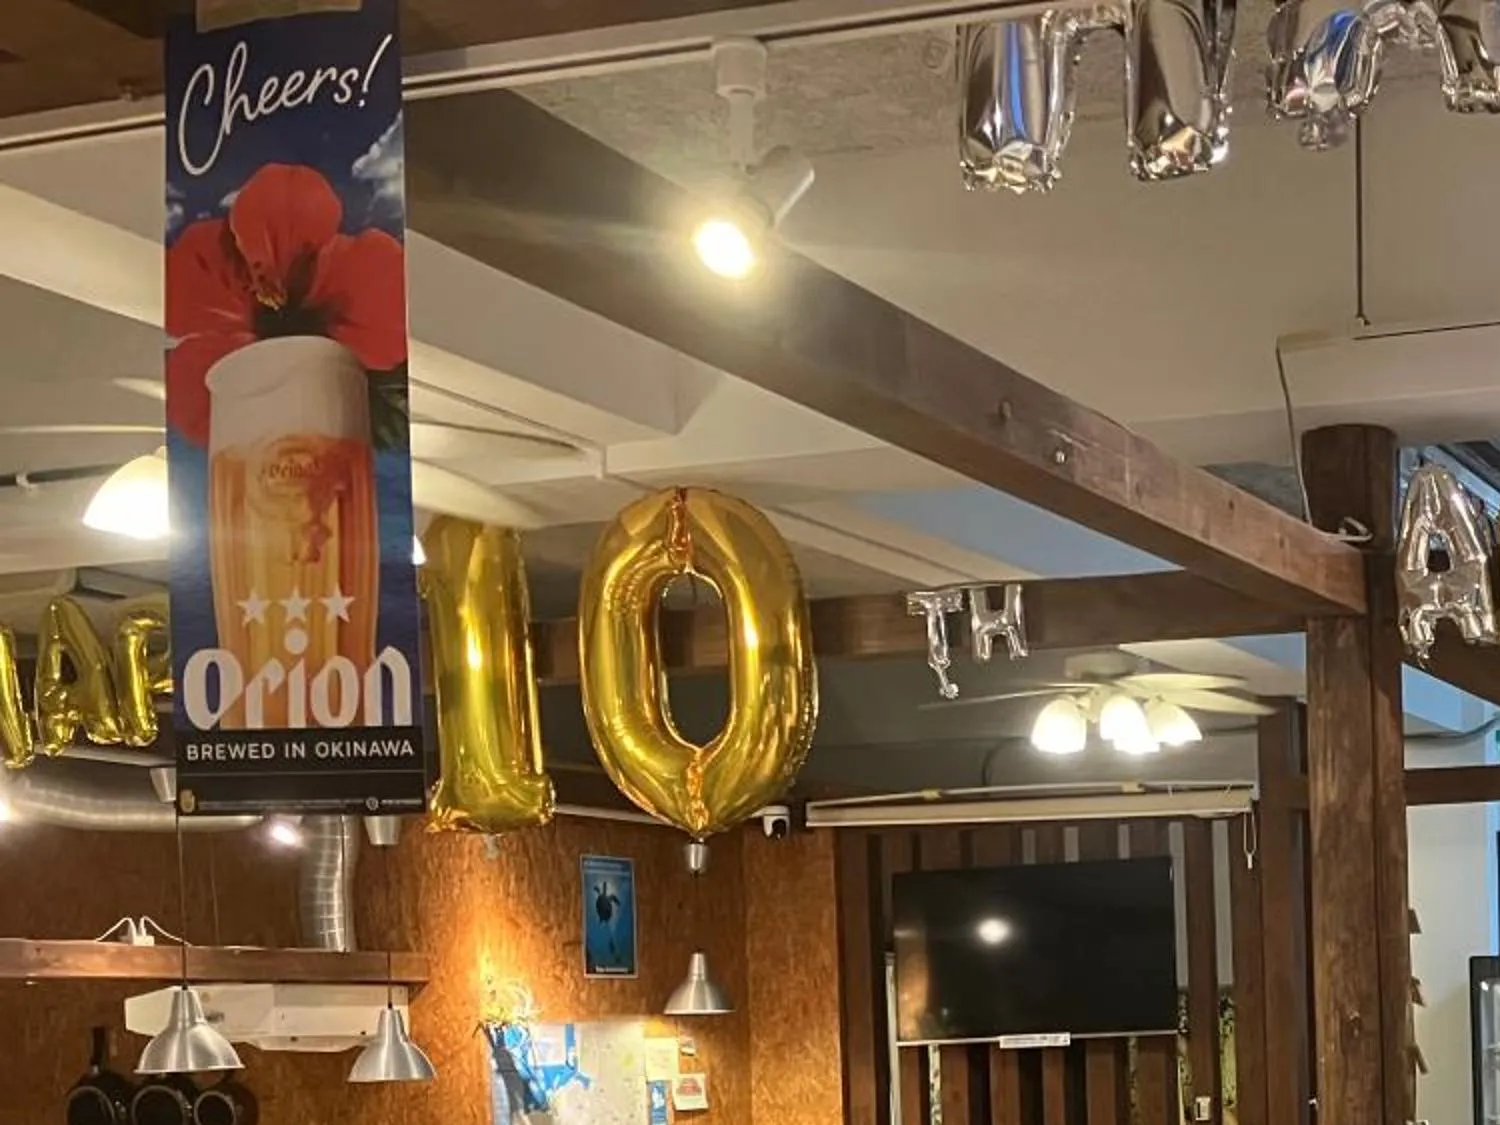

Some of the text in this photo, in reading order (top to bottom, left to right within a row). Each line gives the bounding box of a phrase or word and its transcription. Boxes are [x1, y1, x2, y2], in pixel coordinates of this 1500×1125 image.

[179, 34, 392, 176] Cheers!
[186, 738, 415, 761] BREWED IN OKINAWA
